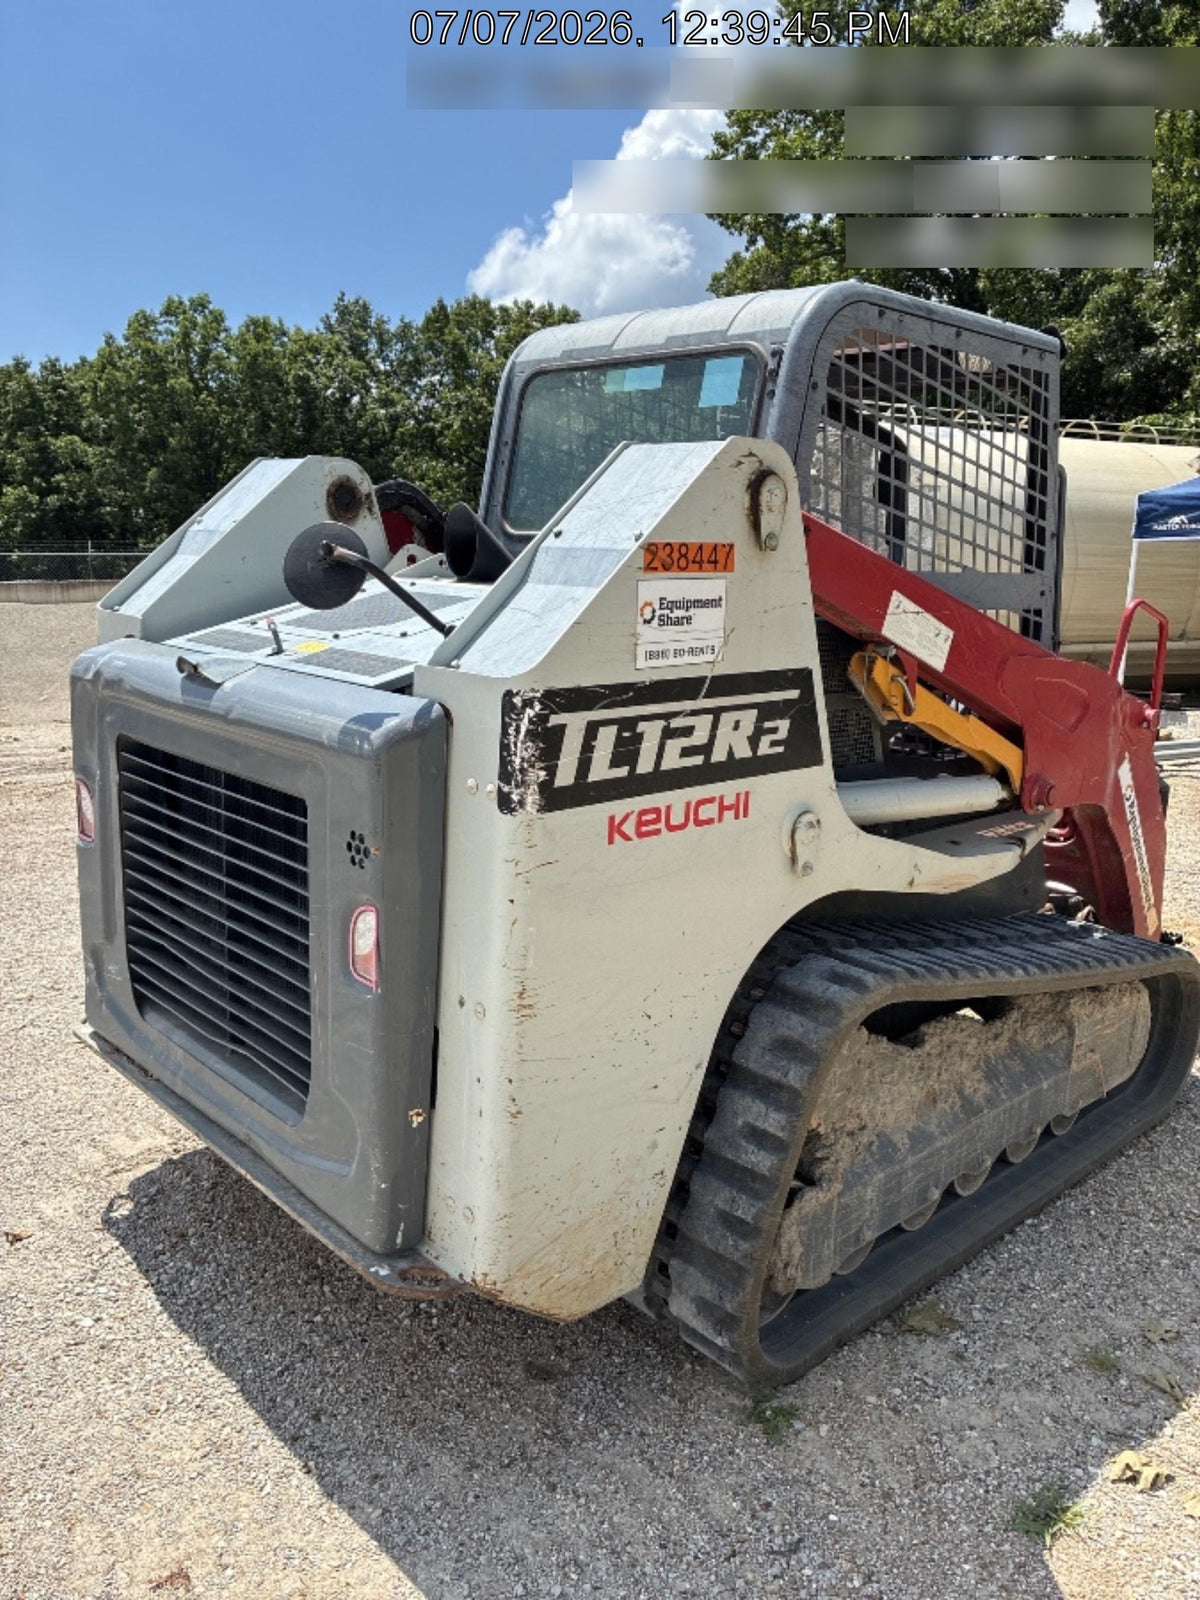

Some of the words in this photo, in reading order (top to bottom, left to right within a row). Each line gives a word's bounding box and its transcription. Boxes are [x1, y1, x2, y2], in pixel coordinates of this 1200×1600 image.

[646, 542, 734, 571] 238447
[658, 595, 723, 613] Equipment
[657, 613, 692, 627] Share
